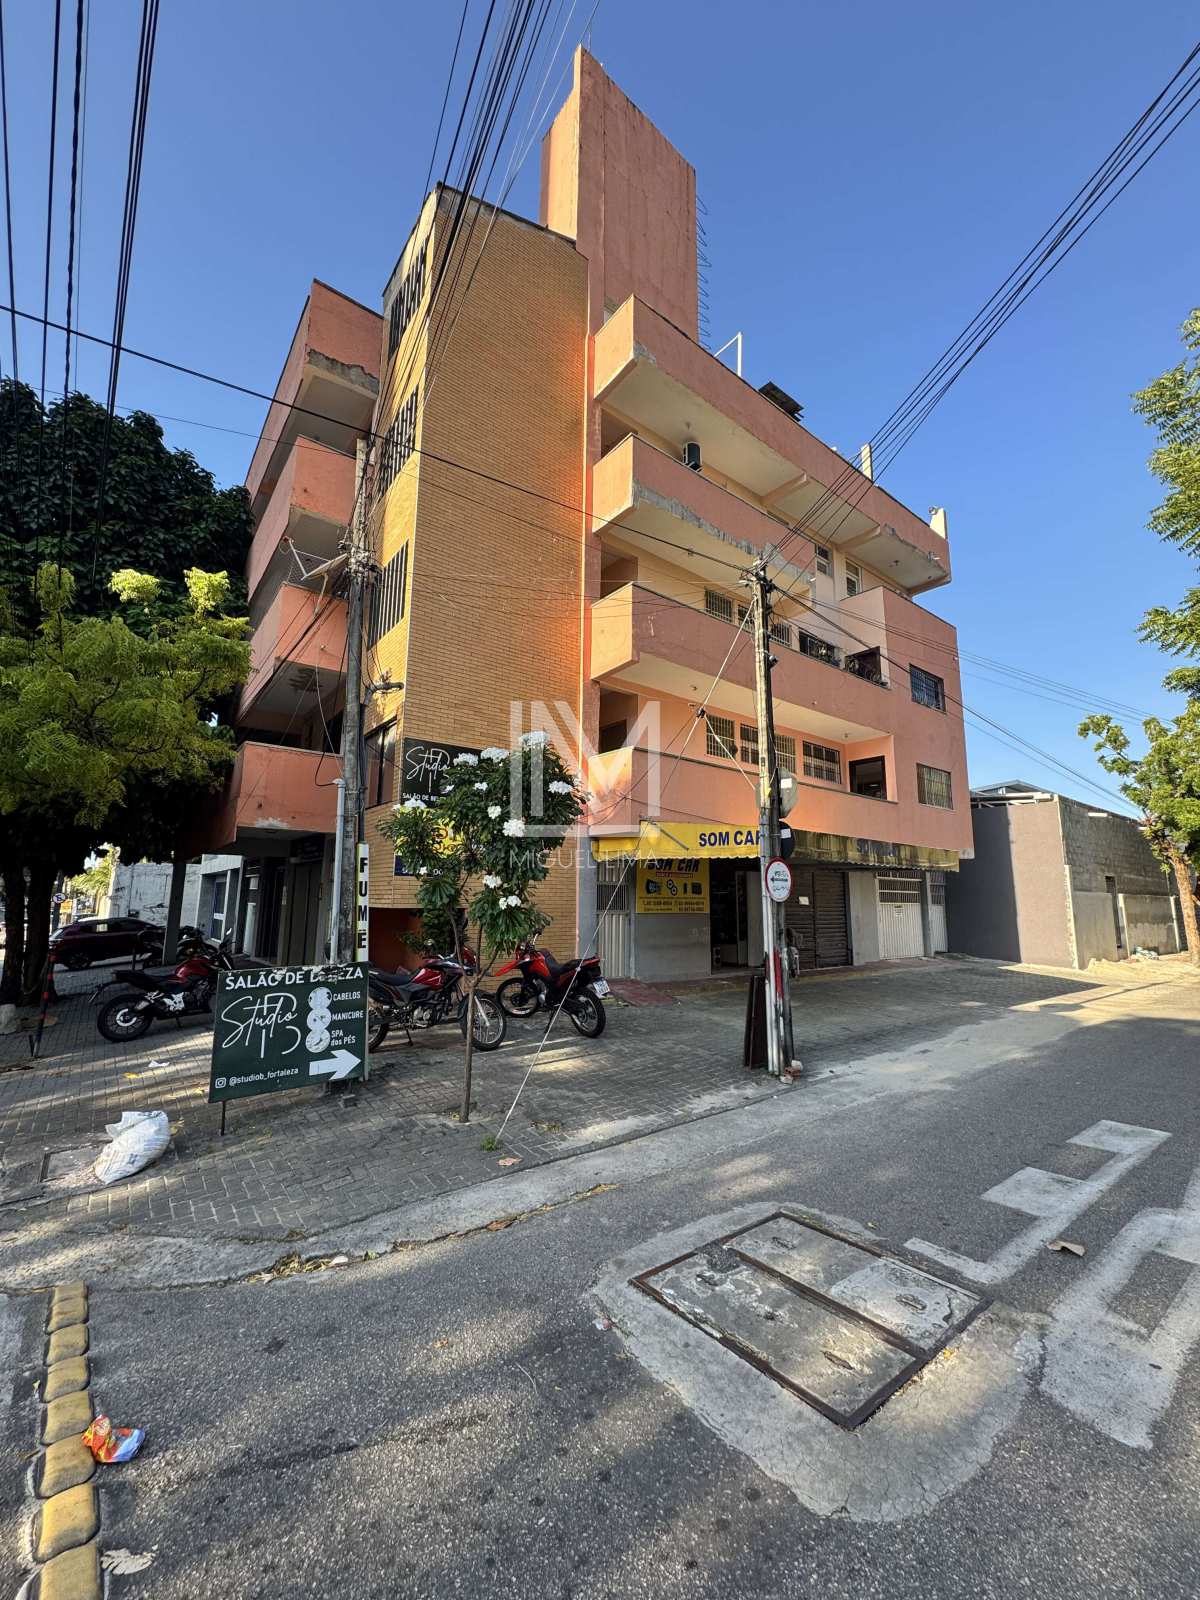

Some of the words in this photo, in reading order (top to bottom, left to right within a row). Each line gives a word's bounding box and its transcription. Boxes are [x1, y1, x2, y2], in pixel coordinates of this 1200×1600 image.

[698, 831, 730, 847] SOM
[285, 970, 305, 985] DE
[333, 991, 361, 1001] CABELOS
[331, 1010, 364, 1021] MANICURE
[331, 1029, 344, 1038] SPA
[343, 1034, 356, 1045] PÉS
[229, 1067, 299, 1087] @studiob_fortaleza
